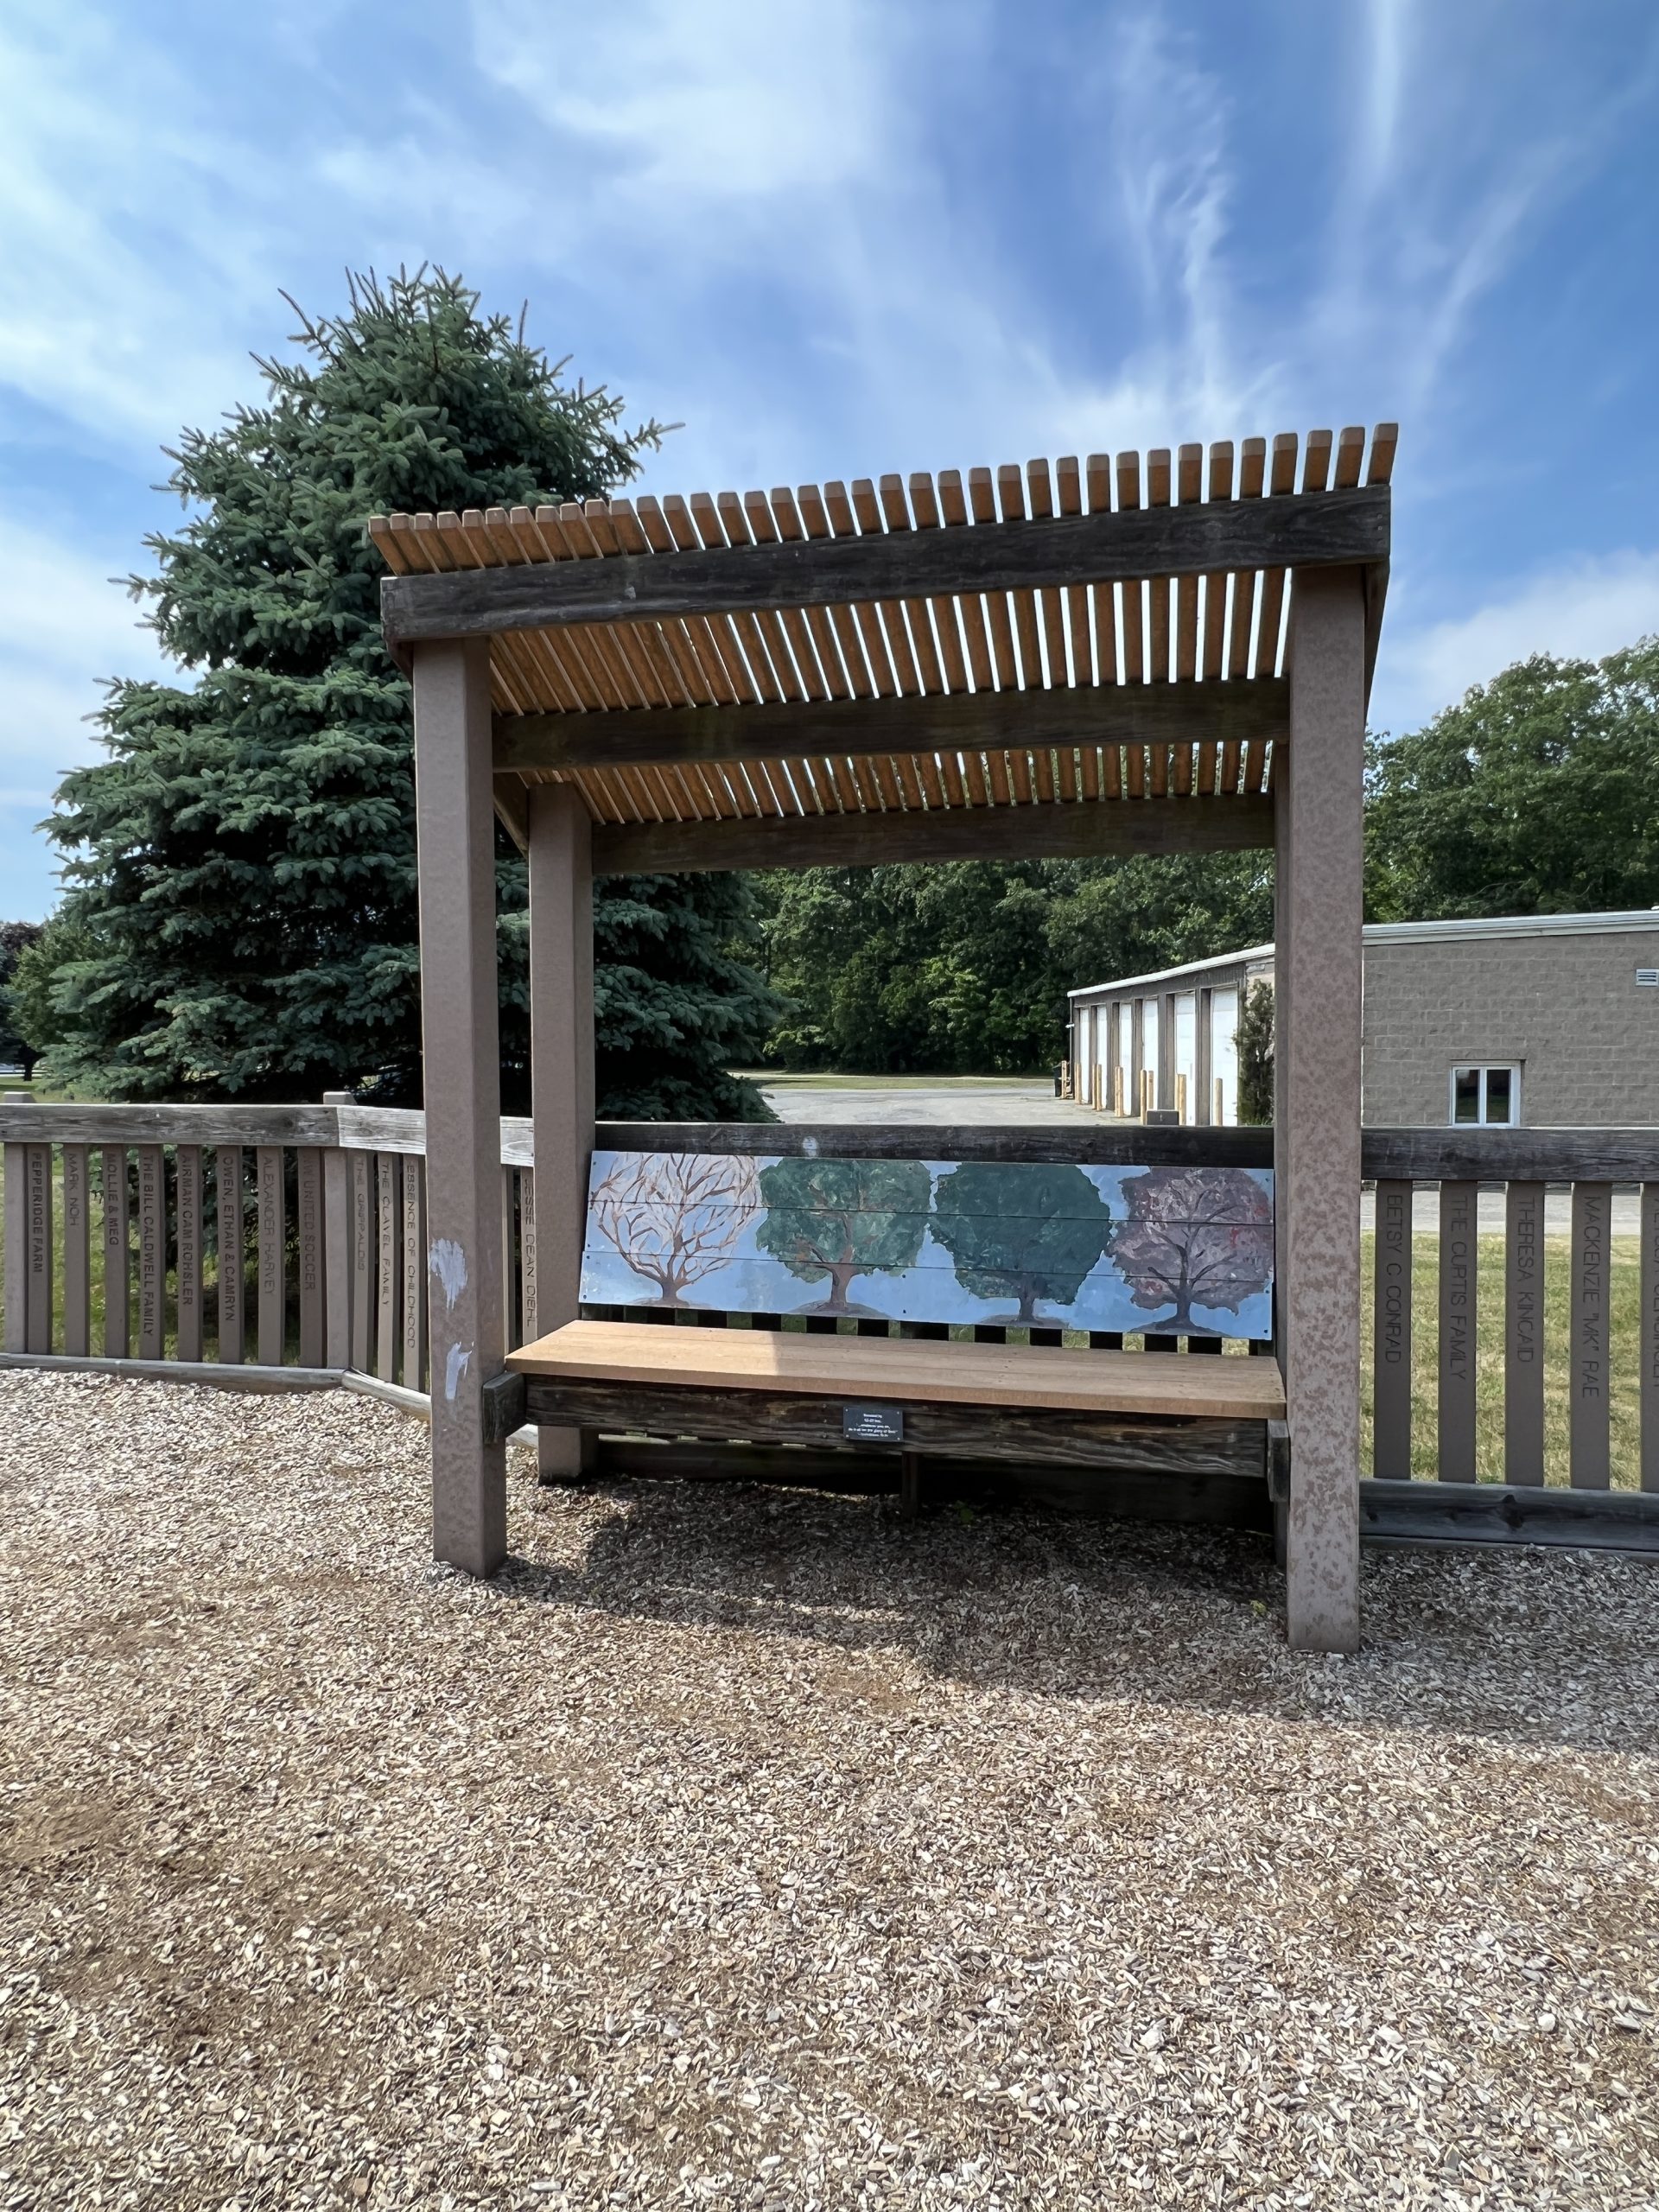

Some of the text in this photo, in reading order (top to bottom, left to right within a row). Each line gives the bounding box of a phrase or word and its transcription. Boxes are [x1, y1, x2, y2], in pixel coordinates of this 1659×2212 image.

[32, 1153, 43, 1273] PEPPERIDGE FARM
[68, 1153, 80, 1226] MARK NOH
[106, 1153, 119, 1246] MOLLIE & MEG
[181, 1154, 194, 1306] AIRMAN CAM ROHSLER
[263, 1156, 276, 1295] ALEXANDER HARVEY
[302, 1180, 316, 1230] UNITED
[355, 1161, 365, 1185] THE
[382, 1196, 391, 1250] CLAVEL
[143, 1154, 155, 1336] THE BILL CALDWELL FAMILY
[222, 1155, 236, 1321] OWEN, ETHAN & CAMRYN
[303, 1235, 317, 1291] SOCCER
[382, 1258, 391, 1306] FAMILY
[407, 1165, 416, 1348] ESSENCE OF CHILDHOOD
[524, 1178, 536, 1328] JESSE DEAN DIEHL
[1384, 1194, 1403, 1363] BETSY C CONRAD
[1449, 1195, 1468, 1381] THE CURTIS FAMILY
[1516, 1196, 1535, 1363] THERESA KINCAID
[1582, 1196, 1602, 1303] MACKENZIE
[1581, 1360, 1599, 1398] RAE
